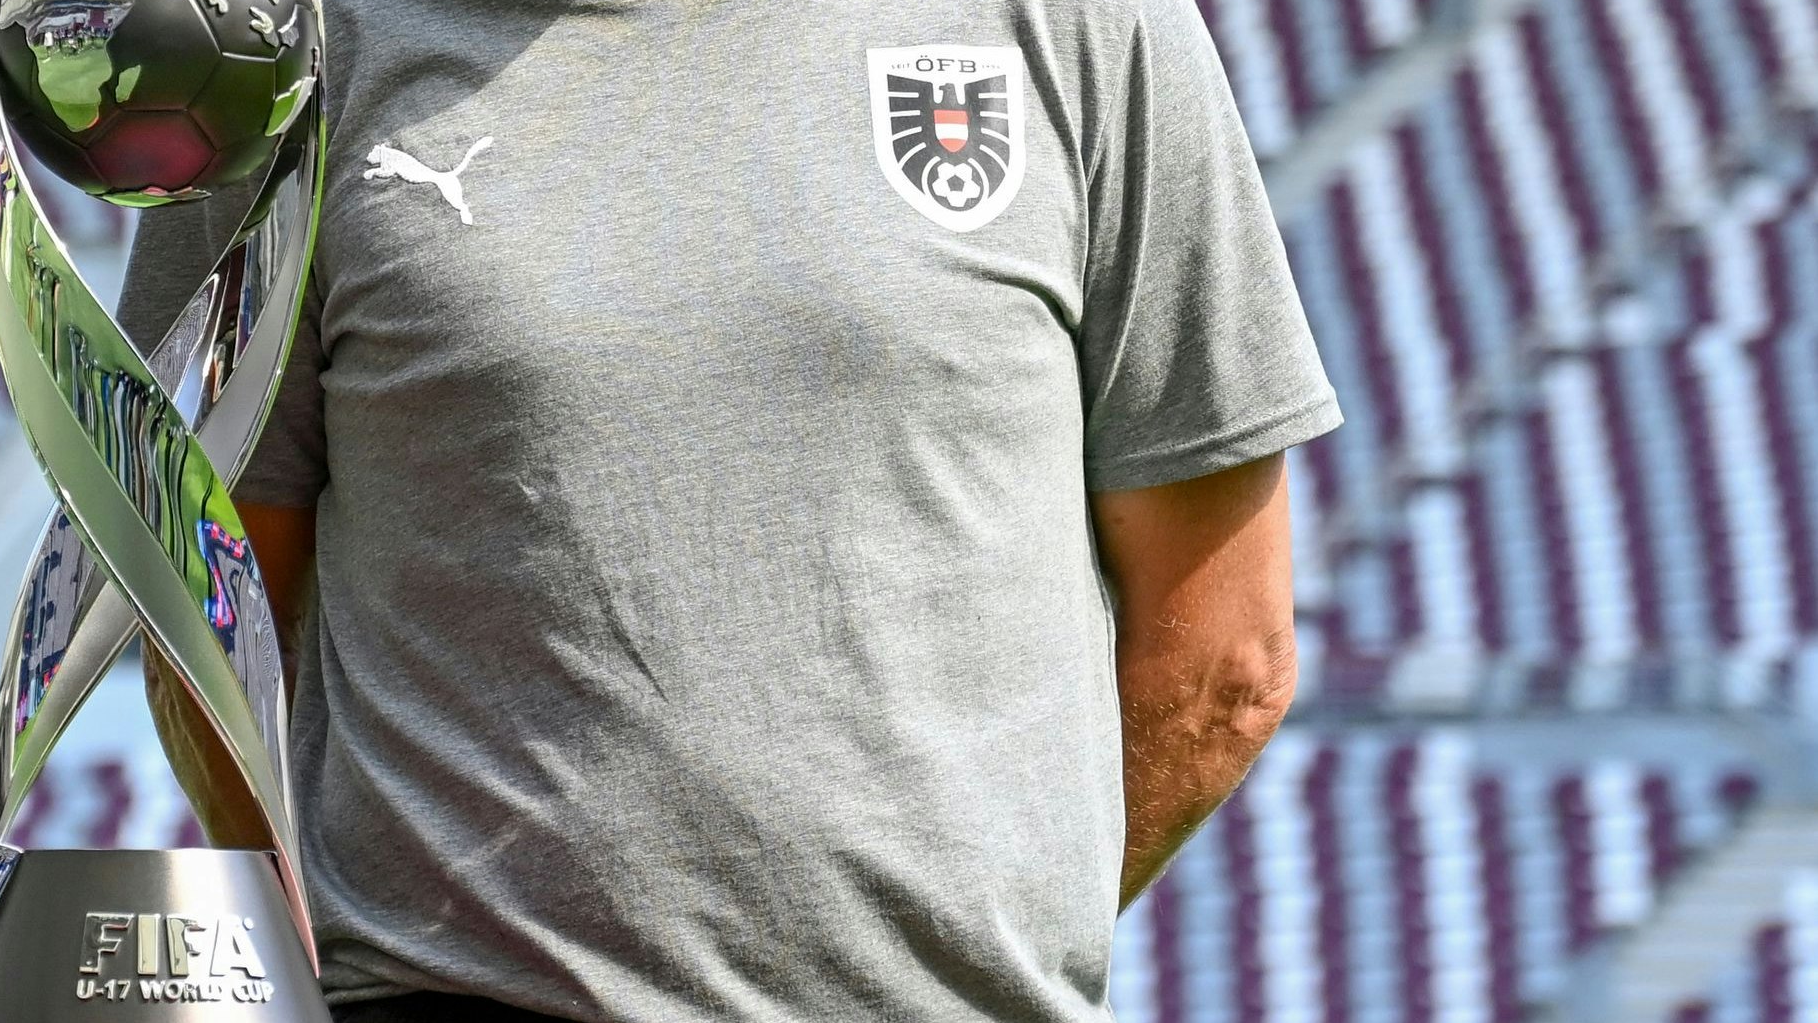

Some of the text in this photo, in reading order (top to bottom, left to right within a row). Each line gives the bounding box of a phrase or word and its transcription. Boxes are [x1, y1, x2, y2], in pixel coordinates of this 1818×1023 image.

[915, 54, 977, 74] ÖFB
[79, 911, 267, 979] FIFA
[75, 978, 132, 1001] U-17
[231, 979, 276, 1003] CUP
